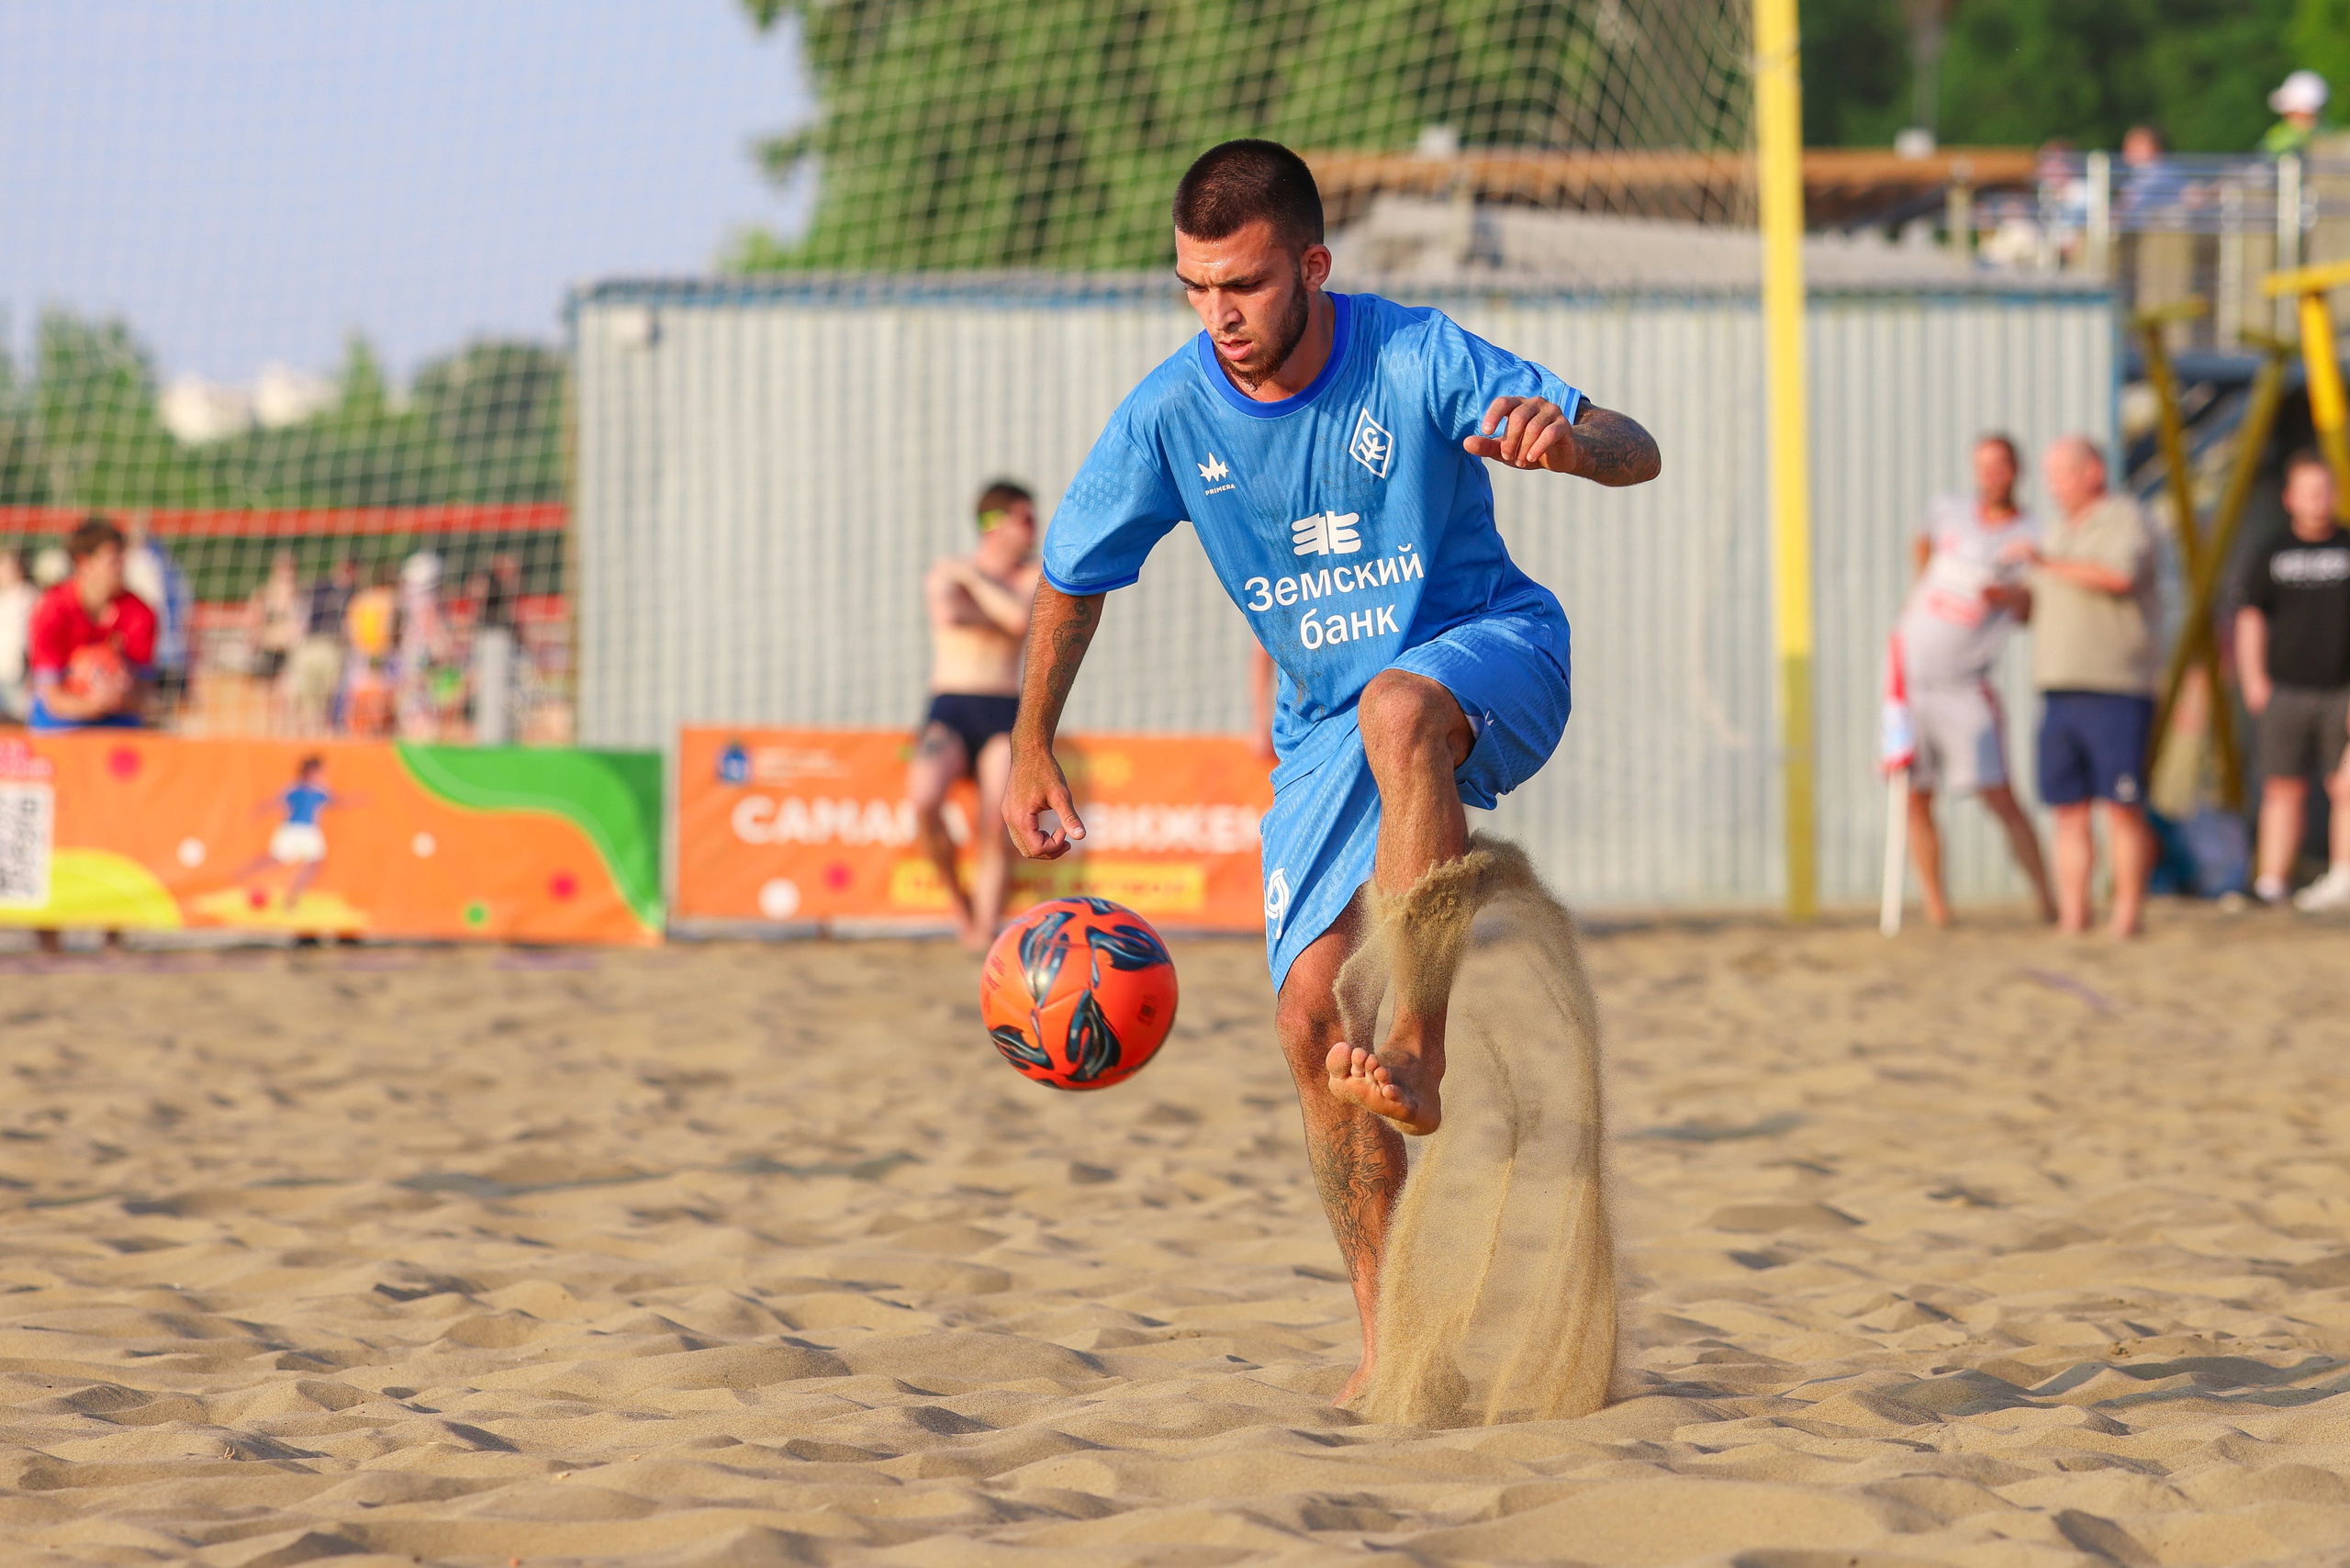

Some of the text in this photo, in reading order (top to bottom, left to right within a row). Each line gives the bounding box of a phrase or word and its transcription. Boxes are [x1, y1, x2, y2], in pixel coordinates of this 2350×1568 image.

[1204, 483, 1237, 497] PRIMERA
[1244, 543, 1425, 612] Земский
[1300, 604, 1400, 651] банк
